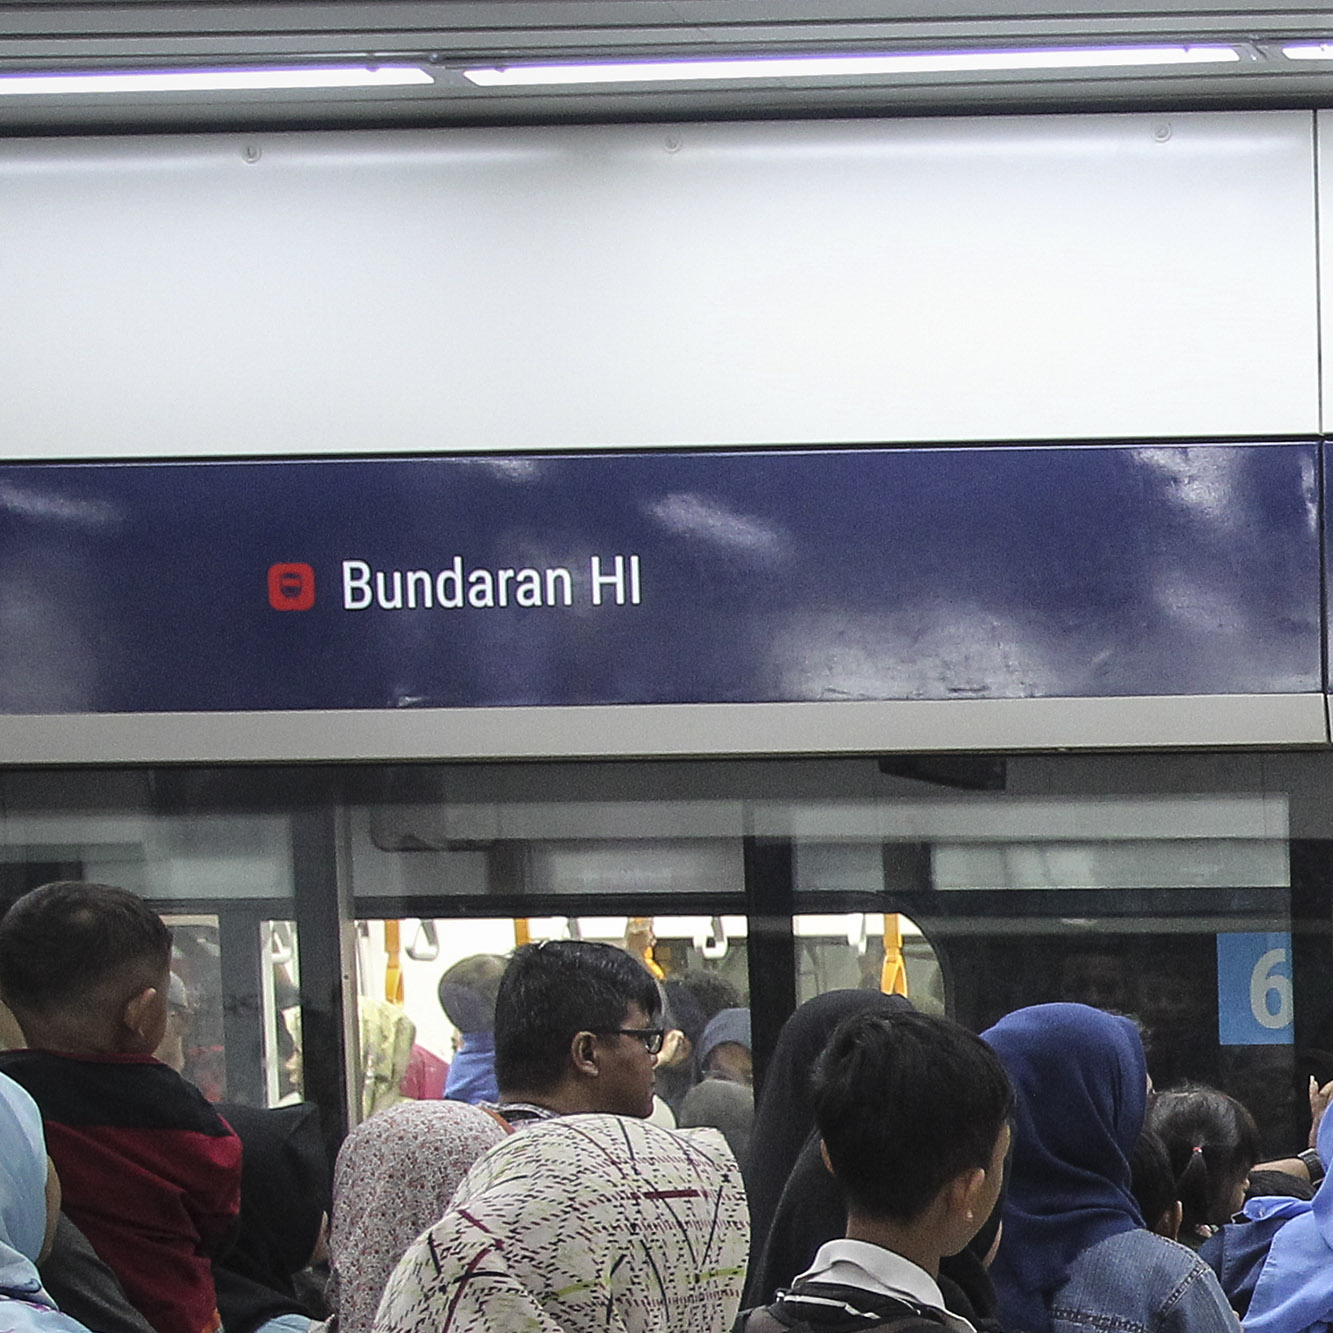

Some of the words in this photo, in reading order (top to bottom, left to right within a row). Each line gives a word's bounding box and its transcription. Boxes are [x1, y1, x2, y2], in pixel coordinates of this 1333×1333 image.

[342, 555, 572, 610] Bundaran
[591, 555, 640, 605] HI
[1250, 948, 1293, 1029] 6
